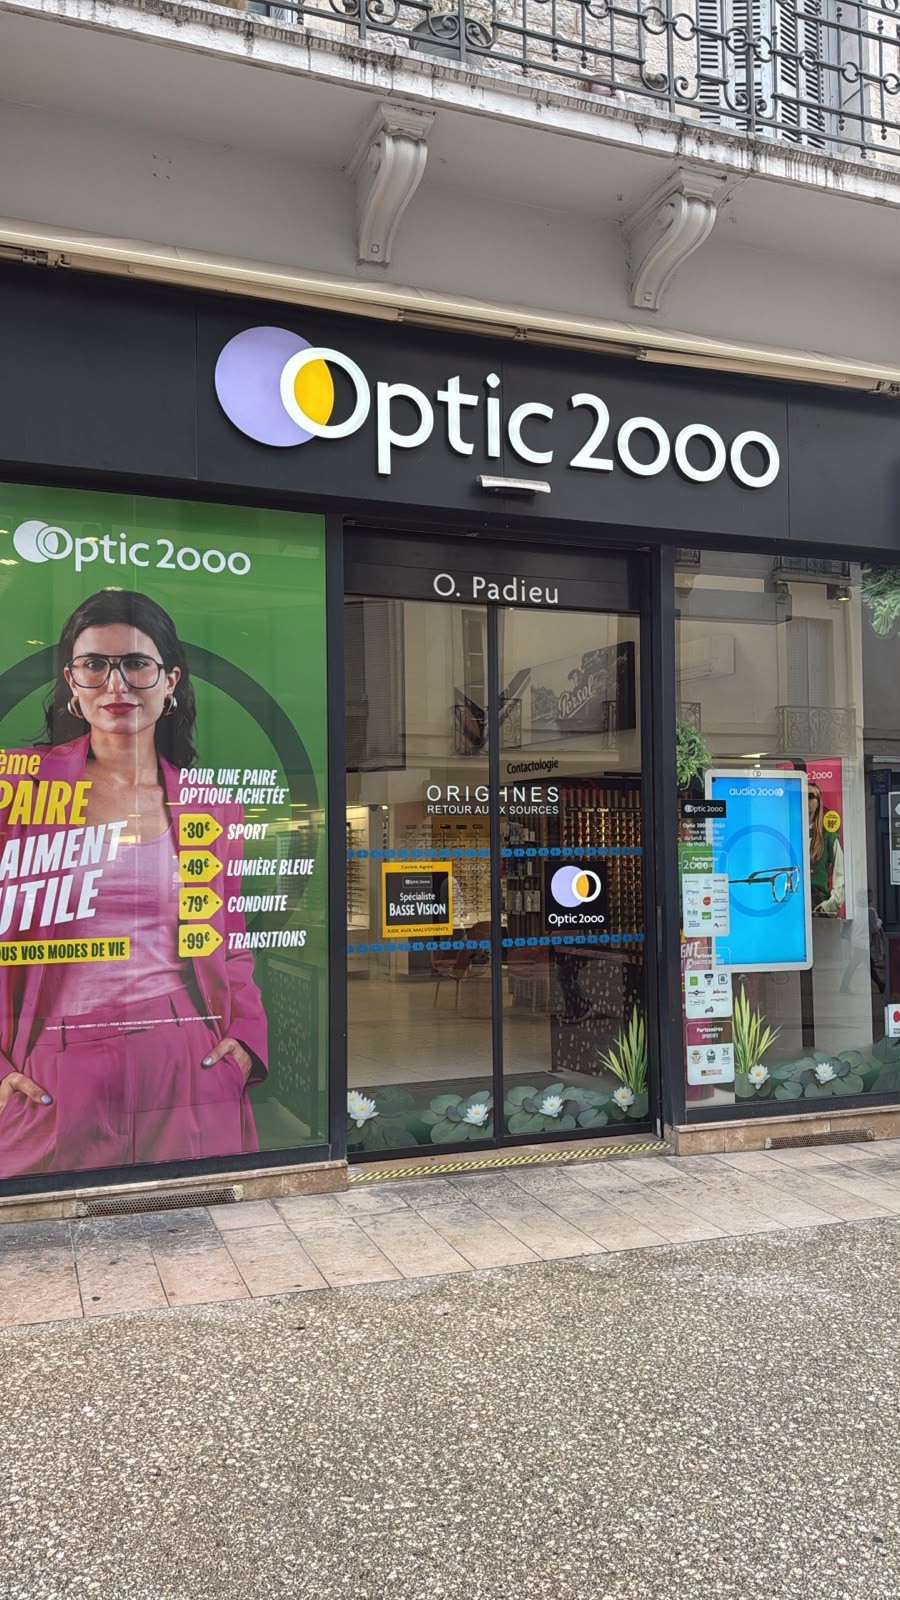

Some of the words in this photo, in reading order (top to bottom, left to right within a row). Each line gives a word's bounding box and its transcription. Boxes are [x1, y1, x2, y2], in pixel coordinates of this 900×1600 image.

[279, 347, 554, 475] Optic
[569, 393, 781, 488] 2000
[36, 526, 150, 572] Optic
[156, 539, 251, 576] 2000
[433, 573, 461, 598] O.
[472, 576, 559, 604] Padieu
[506, 757, 559, 775] Contactologie
[178, 768, 215, 785] POUR
[217, 768, 241, 785] UNE
[242, 769, 278, 786] PAIRE
[811, 771, 833, 780] 2000
[179, 787, 236, 806] OPTIQUE
[729, 788, 757, 796] audio
[427, 805, 472, 815] RETOUR
[509, 805, 559, 815] SOURCES
[227, 823, 269, 840] SPORT
[227, 857, 278, 877] LUMIÈRE
[279, 859, 315, 876] BLEUE
[227, 895, 289, 913] CONDUITE
[399, 891, 436, 903] Spécialiste
[389, 902, 416, 917] BASSE
[416, 901, 446, 916] VISION
[548, 913, 577, 927] Optic
[578, 914, 605, 924] 2000
[228, 930, 307, 950] TRANSITIONS
[0, 946, 18, 961] US
[21, 945, 45, 960] VOS
[48, 943, 88, 960] MODES
[91, 942, 105, 958] DE
[108, 941, 126, 957] VIE
